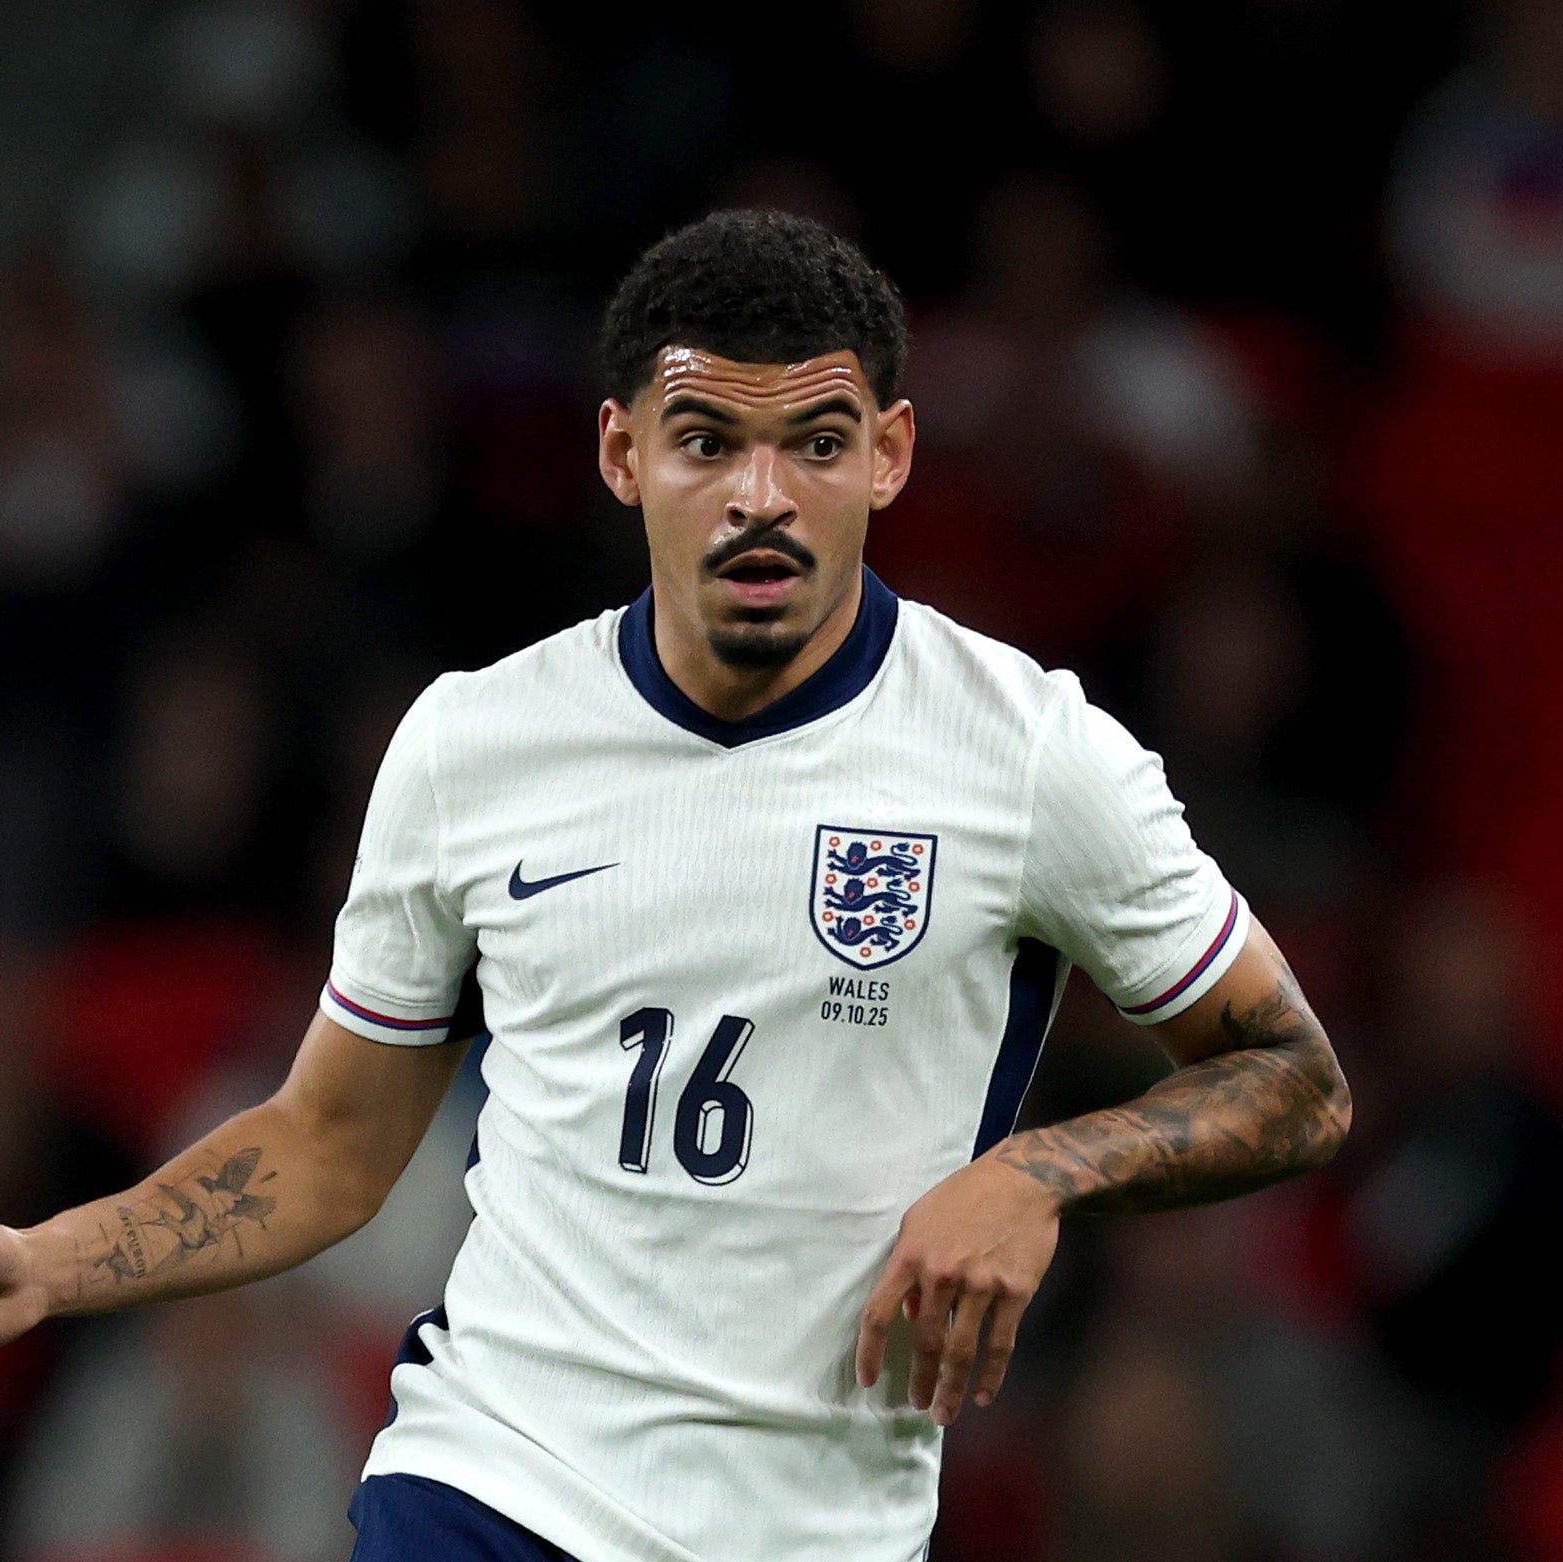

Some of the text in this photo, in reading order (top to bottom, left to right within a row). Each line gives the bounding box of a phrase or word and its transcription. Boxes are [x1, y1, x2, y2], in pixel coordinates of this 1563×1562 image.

[829, 976, 890, 1002] WALES
[821, 1001, 889, 1026] 09.10.25
[619, 1007, 755, 1186] 16
